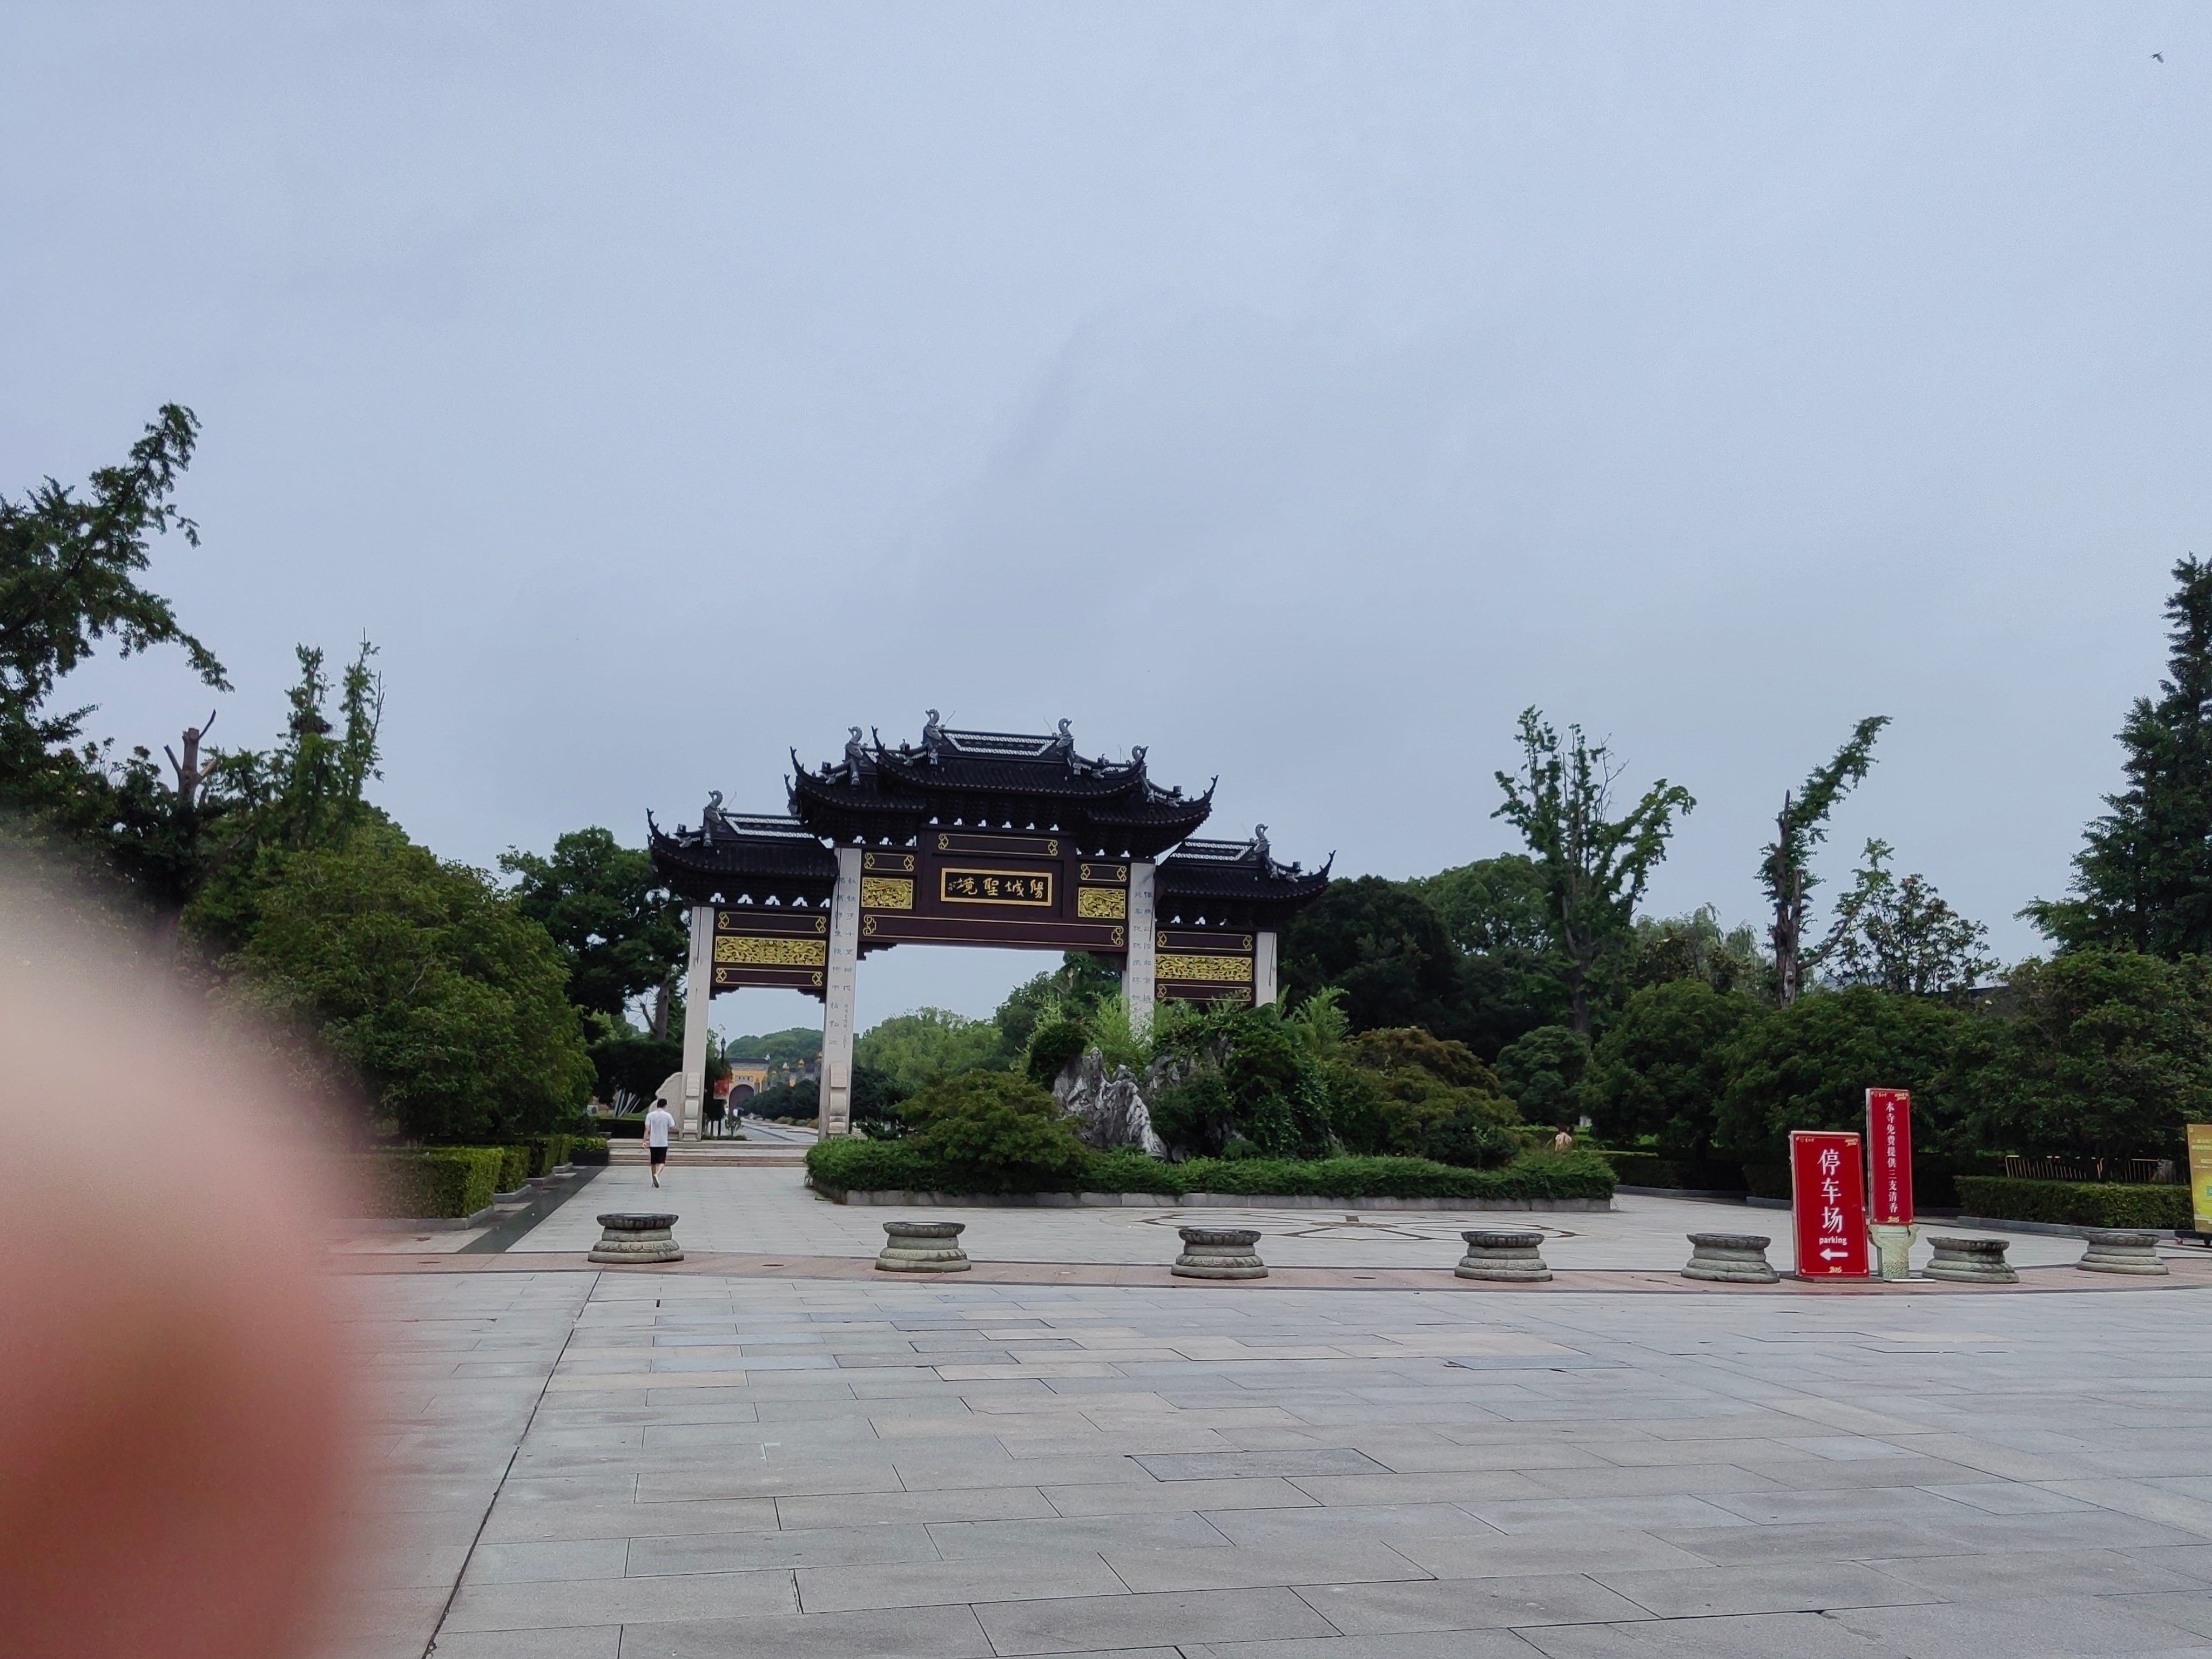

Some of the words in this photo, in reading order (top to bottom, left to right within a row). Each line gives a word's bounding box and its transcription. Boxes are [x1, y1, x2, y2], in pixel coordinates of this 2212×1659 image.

[1817, 1149, 1843, 1233] 停车场
[1819, 1236, 1847, 1246] parking
